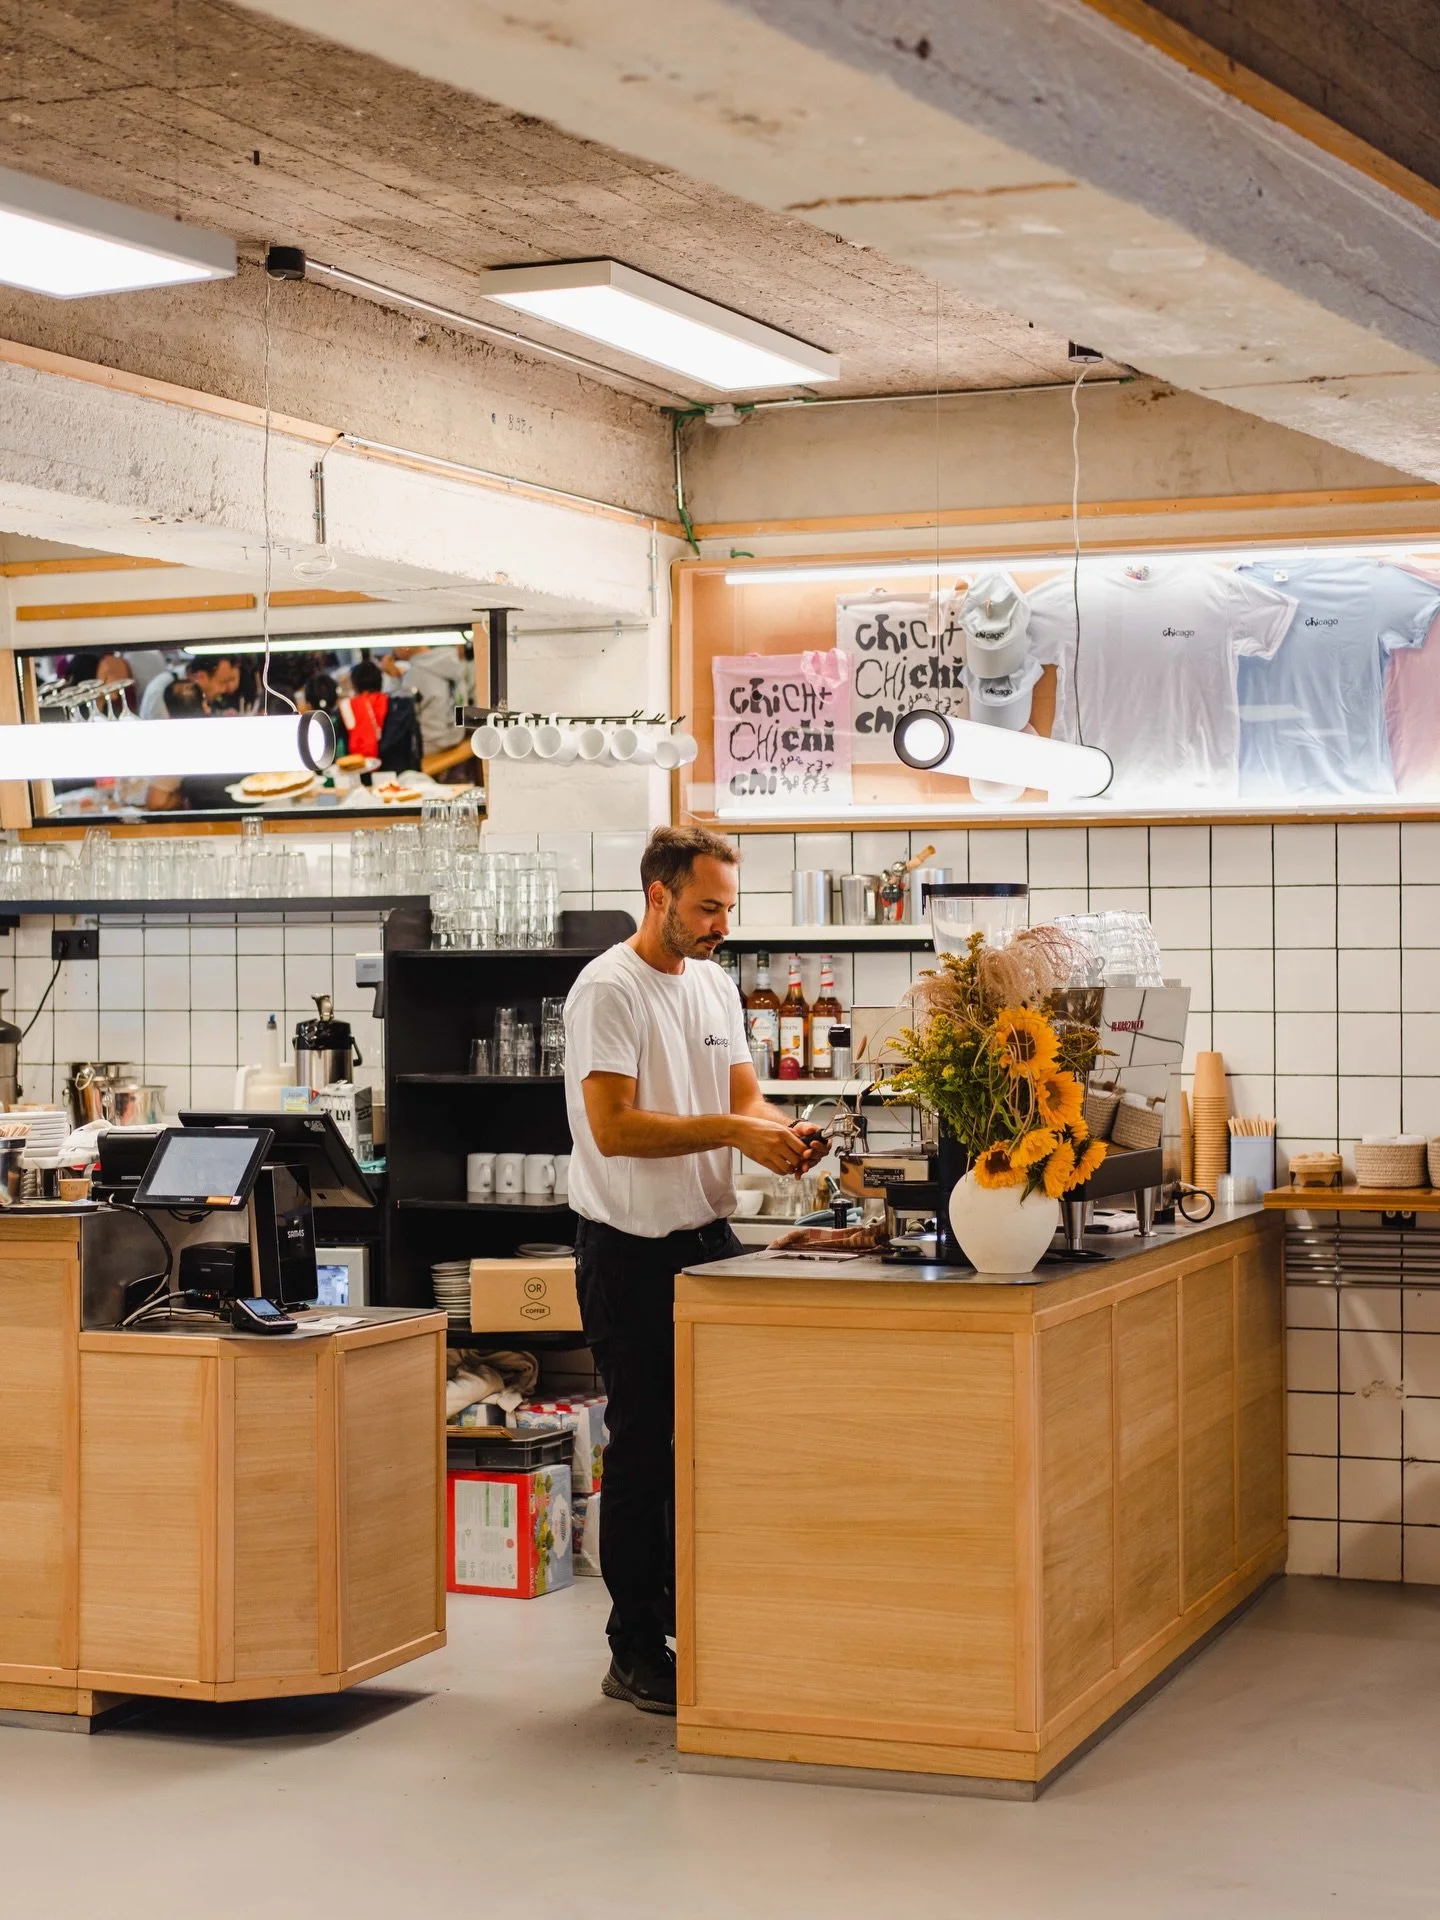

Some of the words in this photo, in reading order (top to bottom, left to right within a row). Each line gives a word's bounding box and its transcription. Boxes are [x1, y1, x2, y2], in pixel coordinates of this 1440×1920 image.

[1305, 616, 1339, 628] chicago
[975, 631, 1005, 641] chicago
[1162, 626, 1195, 639] chicago
[985, 687, 1013, 697] chicago
[704, 1035, 730, 1048] chicag
[528, 1284, 542, 1293] OR
